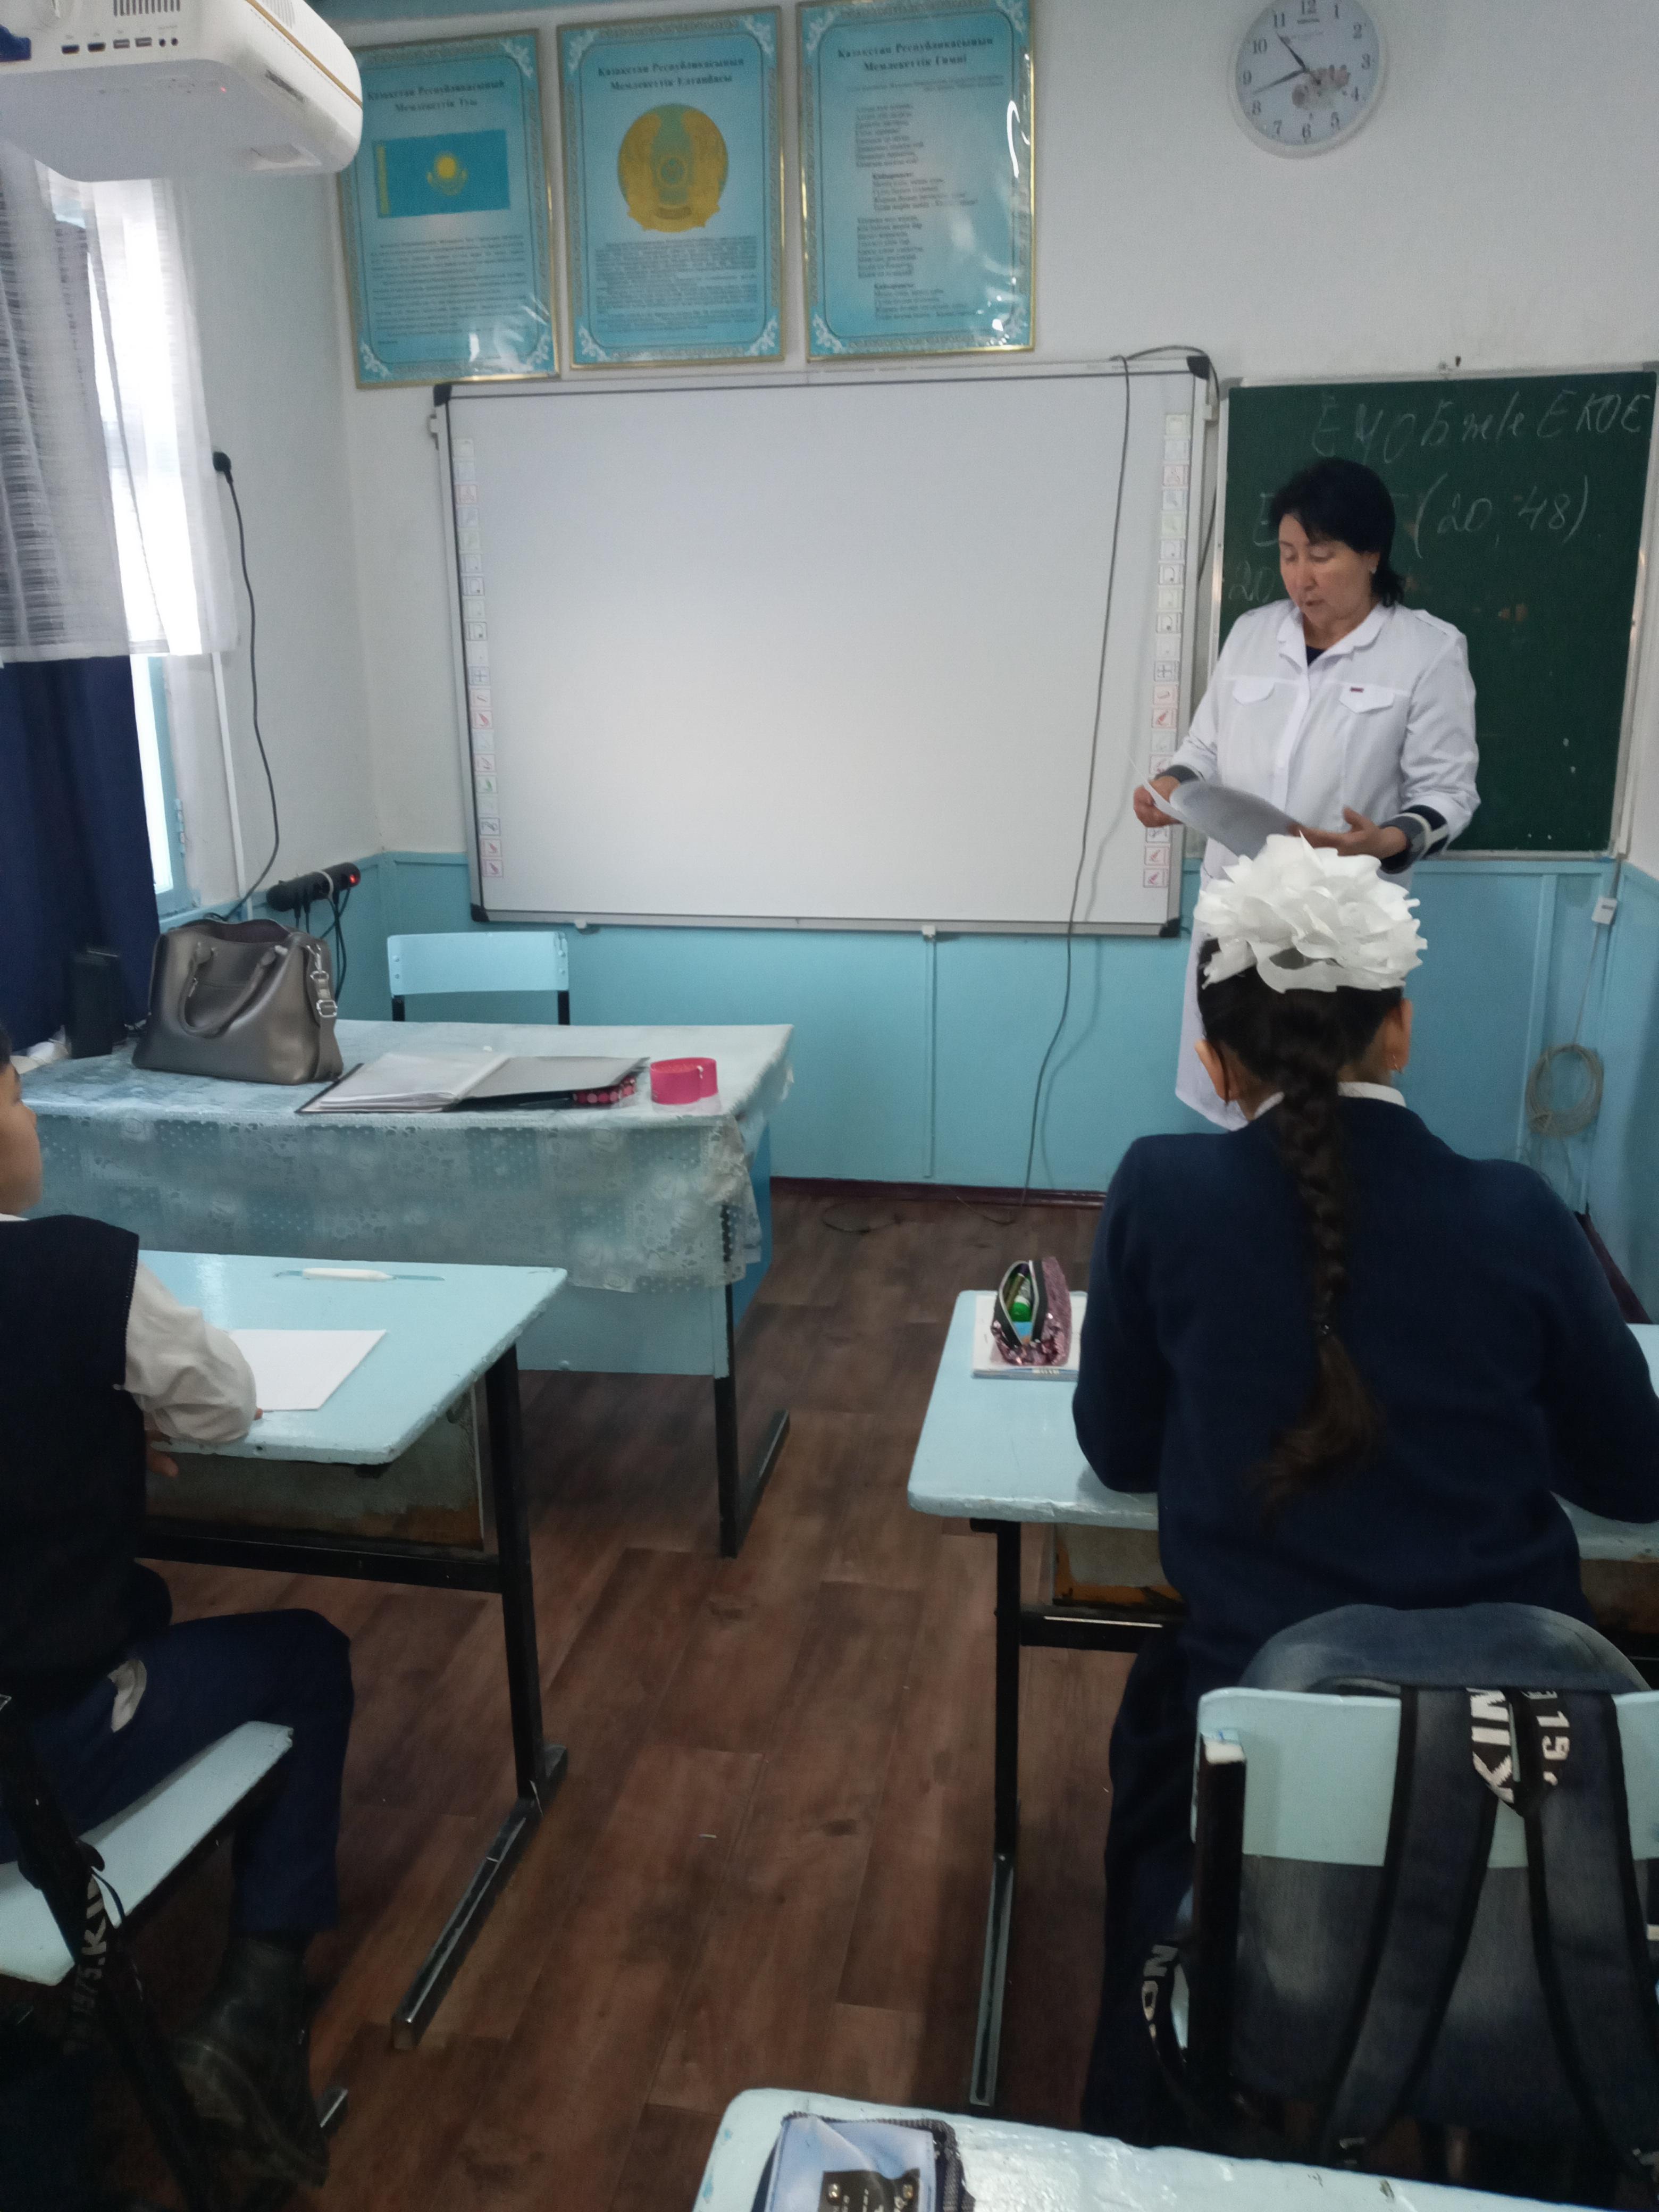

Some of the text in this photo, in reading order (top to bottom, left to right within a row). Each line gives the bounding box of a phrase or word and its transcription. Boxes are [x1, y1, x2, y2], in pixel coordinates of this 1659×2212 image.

[1353, 23, 1362, 39] 2
[1253, 39, 1268, 54] 10
[1361, 54, 1371, 70] 3
[1242, 70, 1252, 85] 9
[1351, 86, 1359, 102] 4
[1252, 100, 1261, 115] 8
[1273, 120, 1283, 135] 7
